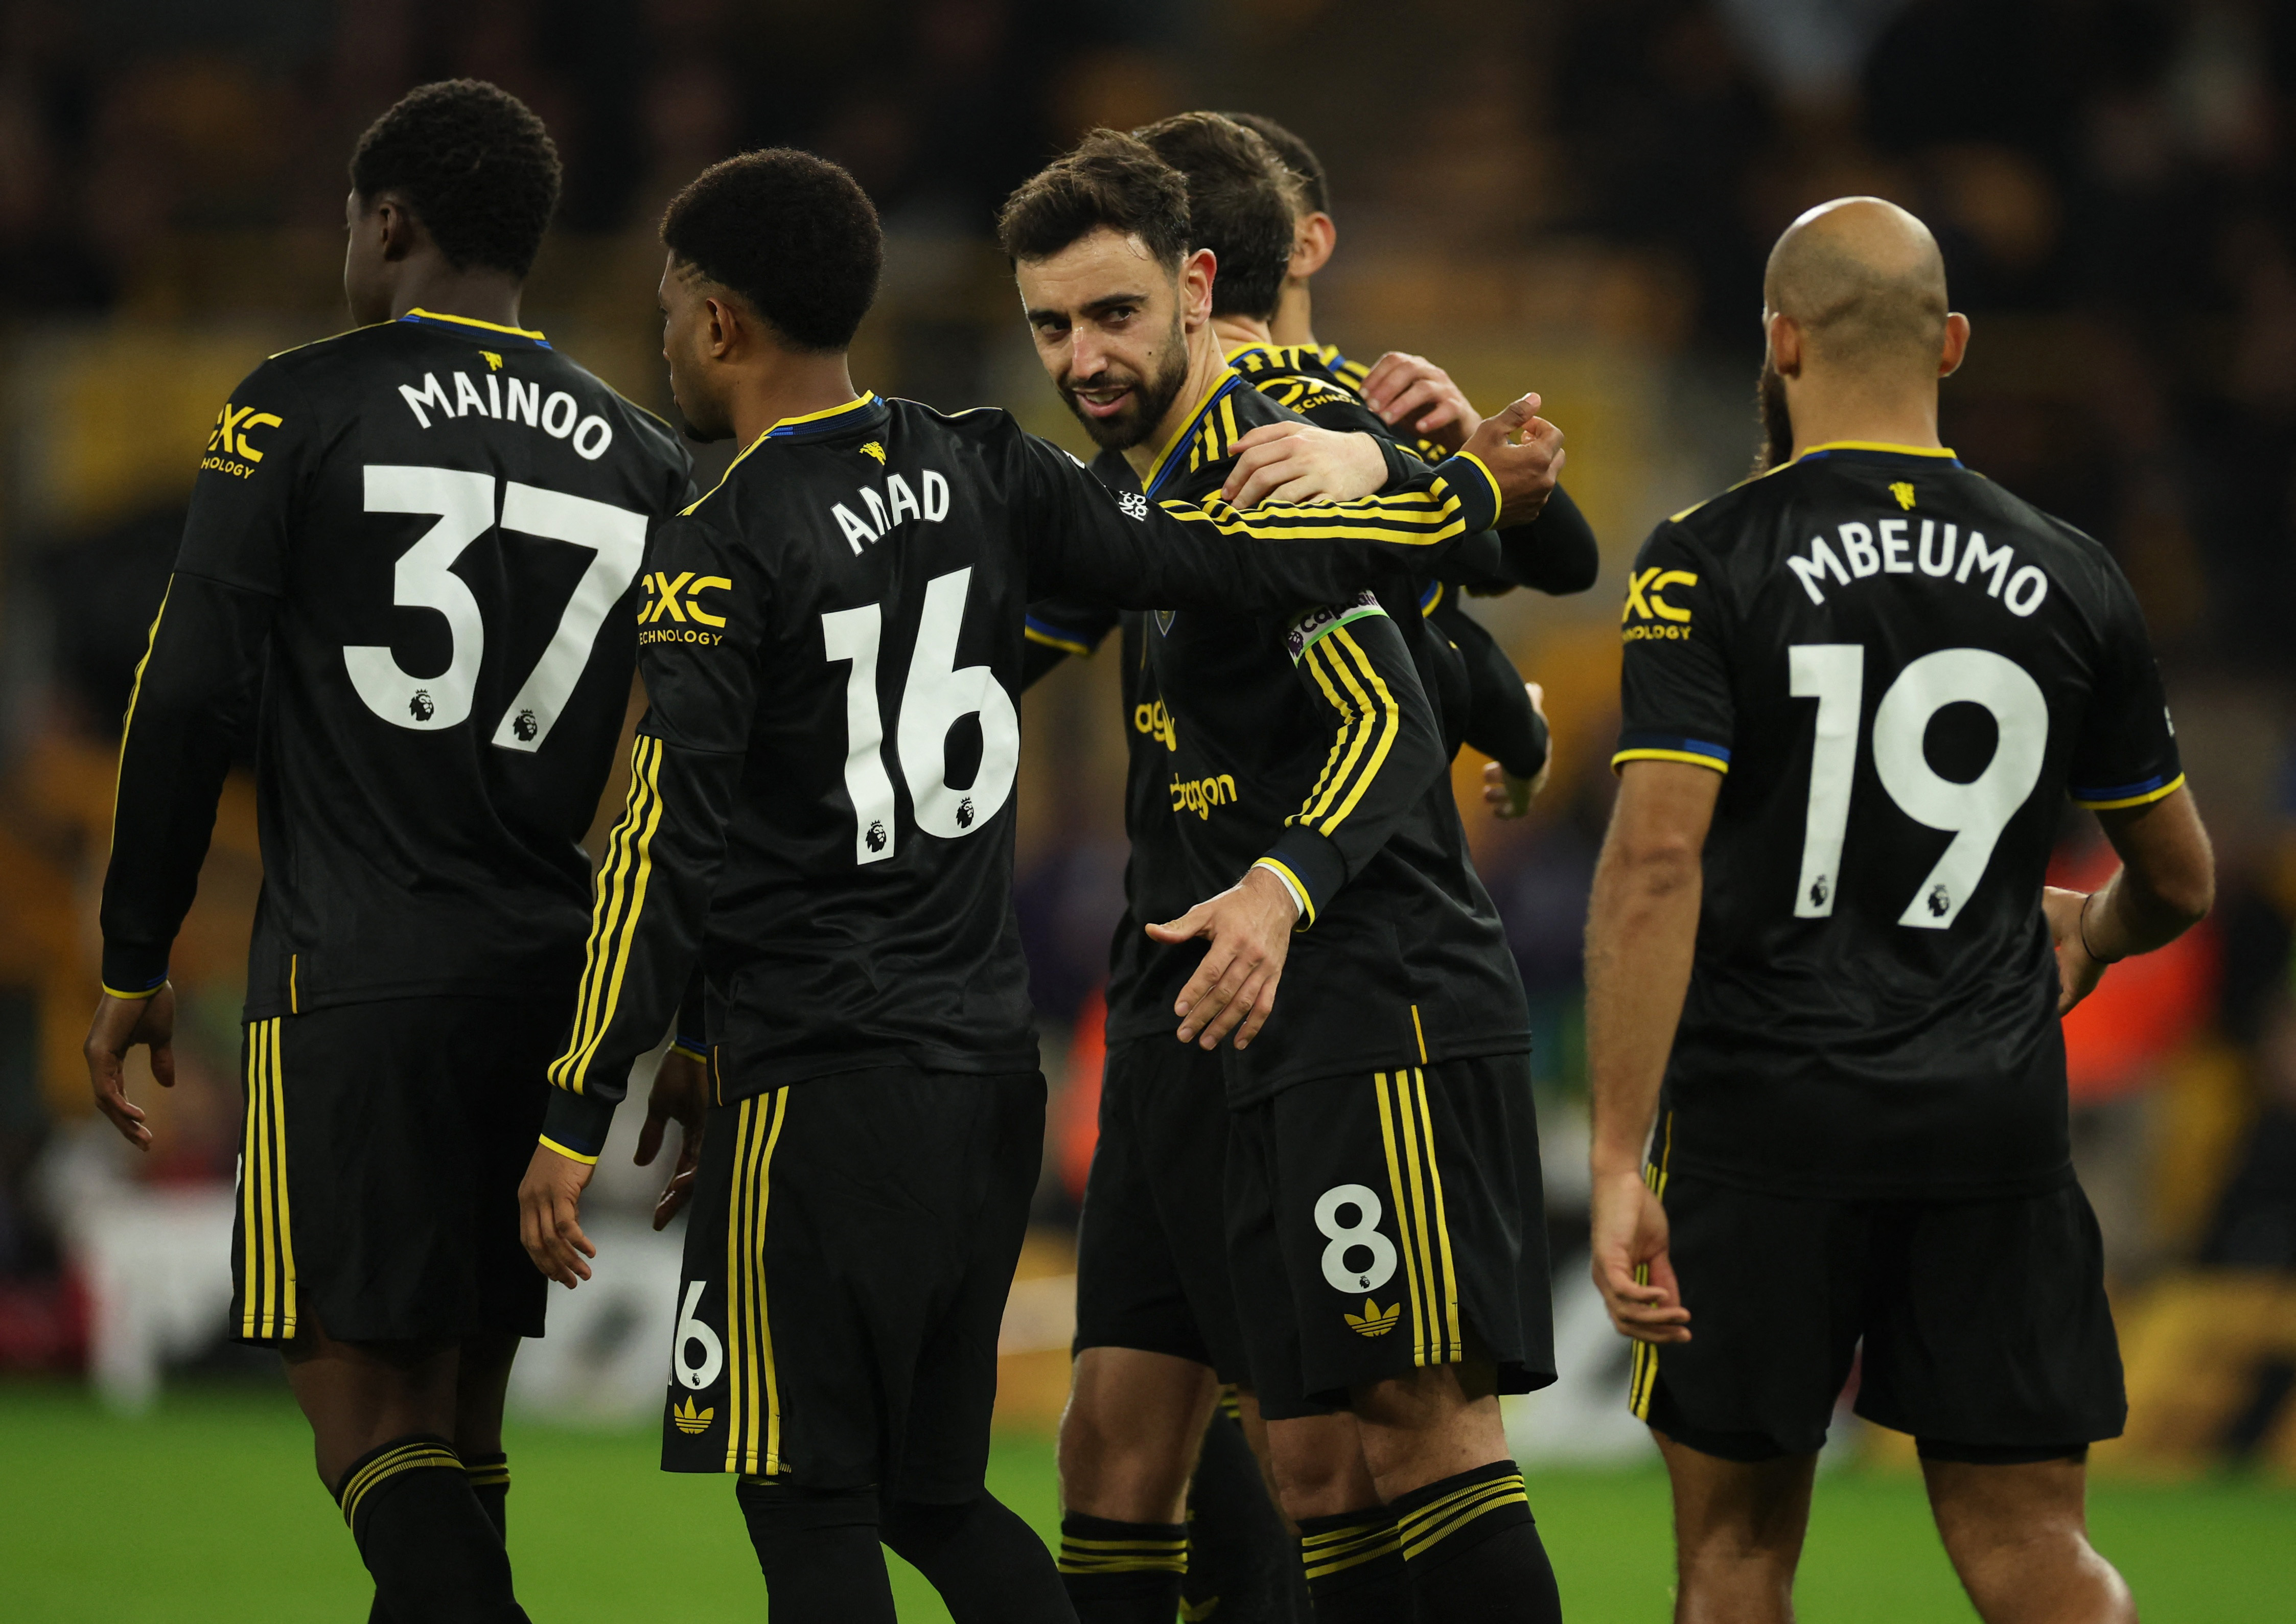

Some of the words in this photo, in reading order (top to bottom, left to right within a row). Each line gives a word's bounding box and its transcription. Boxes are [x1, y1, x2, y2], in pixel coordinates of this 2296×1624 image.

[398, 372, 613, 460] MAINOO
[831, 469, 950, 556] AMAD
[343, 465, 648, 752] 37
[1787, 519, 2048, 617] MBEUMO
[639, 630, 723, 646] ECHNOLOGY
[821, 567, 1020, 865] 16
[1788, 644, 2048, 929] 19
[1314, 1184, 1398, 1293] 8
